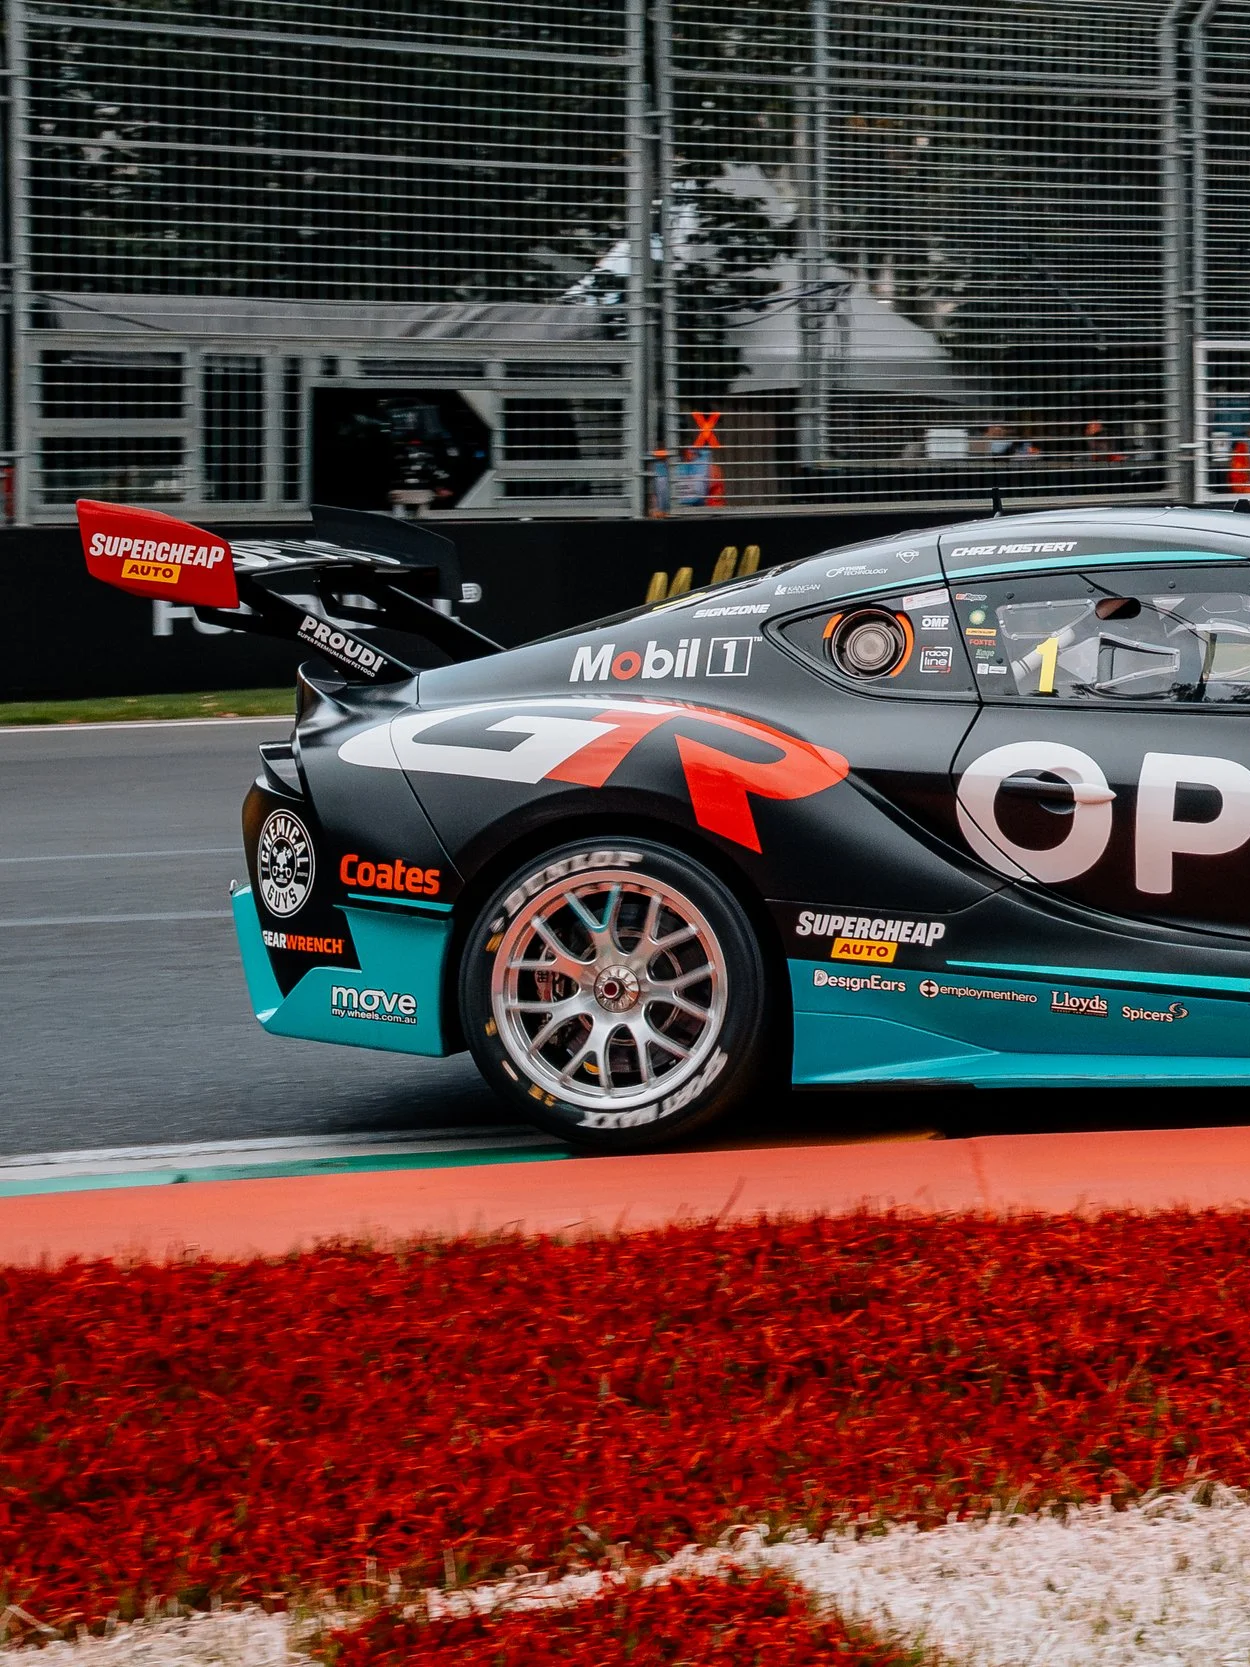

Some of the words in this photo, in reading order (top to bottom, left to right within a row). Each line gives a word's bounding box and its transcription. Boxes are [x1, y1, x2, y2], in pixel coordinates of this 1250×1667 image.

[89, 532, 225, 569] SUPERCHEAP
[951, 545, 997, 557] CHAZ
[997, 541, 1077, 554] MOSTERT
[127, 564, 174, 579] AUTO
[787, 584, 820, 592] KANGAN
[693, 603, 770, 619] SIGNZONE
[922, 618, 949, 628] OMP
[297, 631, 314, 644] SUPER
[314, 641, 340, 658] PREMIUM
[360, 665, 375, 677] FOOD
[300, 615, 384, 672] PROUDI
[569, 638, 701, 683] Mobil
[722, 641, 738, 673] 1
[924, 657, 948, 666] line
[1036, 637, 1058, 692] 1
[337, 699, 850, 854] GR
[262, 818, 309, 868] CHEMICAL
[339, 853, 441, 895] Coates
[267, 885, 298, 909] GUYS
[796, 911, 945, 946] SUPERCHEAP
[262, 930, 343, 954] GEARWRENCH
[839, 943, 889, 958] AUTO
[813, 969, 906, 992] DesignEars
[332, 986, 417, 1015] move
[940, 985, 1037, 1004] employmenthero
[1051, 991, 1107, 1011] Lloyds
[332, 1008, 344, 1018] my
[347, 1010, 417, 1024] wheels.com.au
[1122, 1006, 1173, 1022] Spicers
